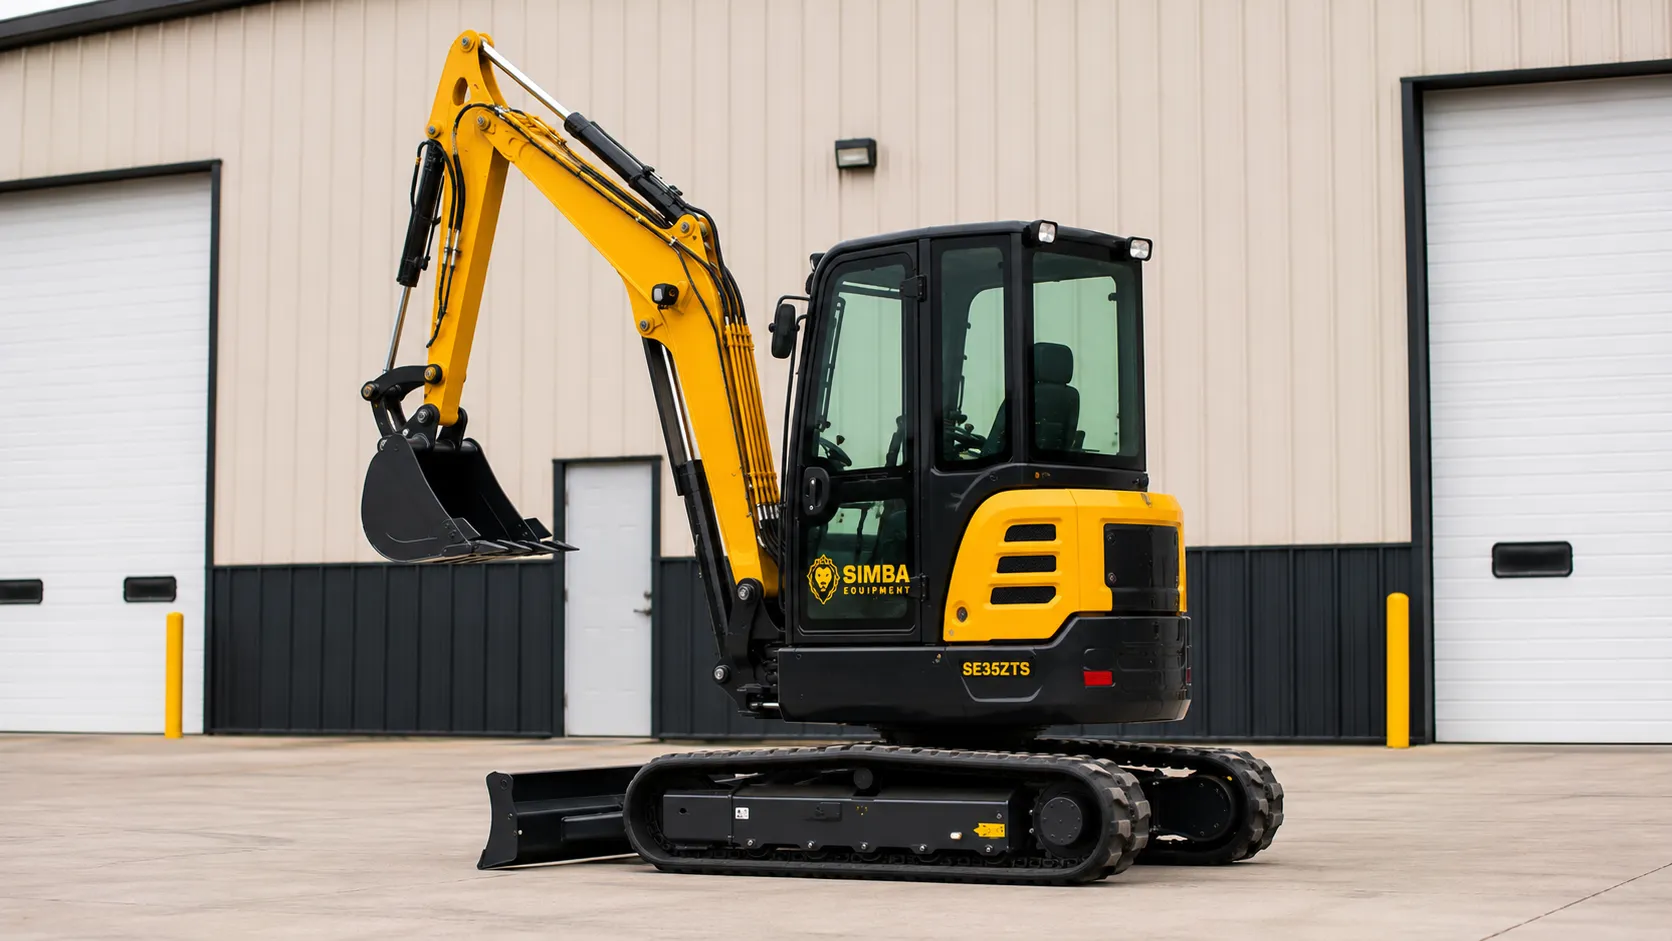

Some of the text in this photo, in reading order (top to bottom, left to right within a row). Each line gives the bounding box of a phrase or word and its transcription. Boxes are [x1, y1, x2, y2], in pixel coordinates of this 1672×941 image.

[842, 564, 910, 584] SIMBA
[843, 585, 910, 595] EQUIPMENT
[962, 661, 1031, 676] SE35ZTS
